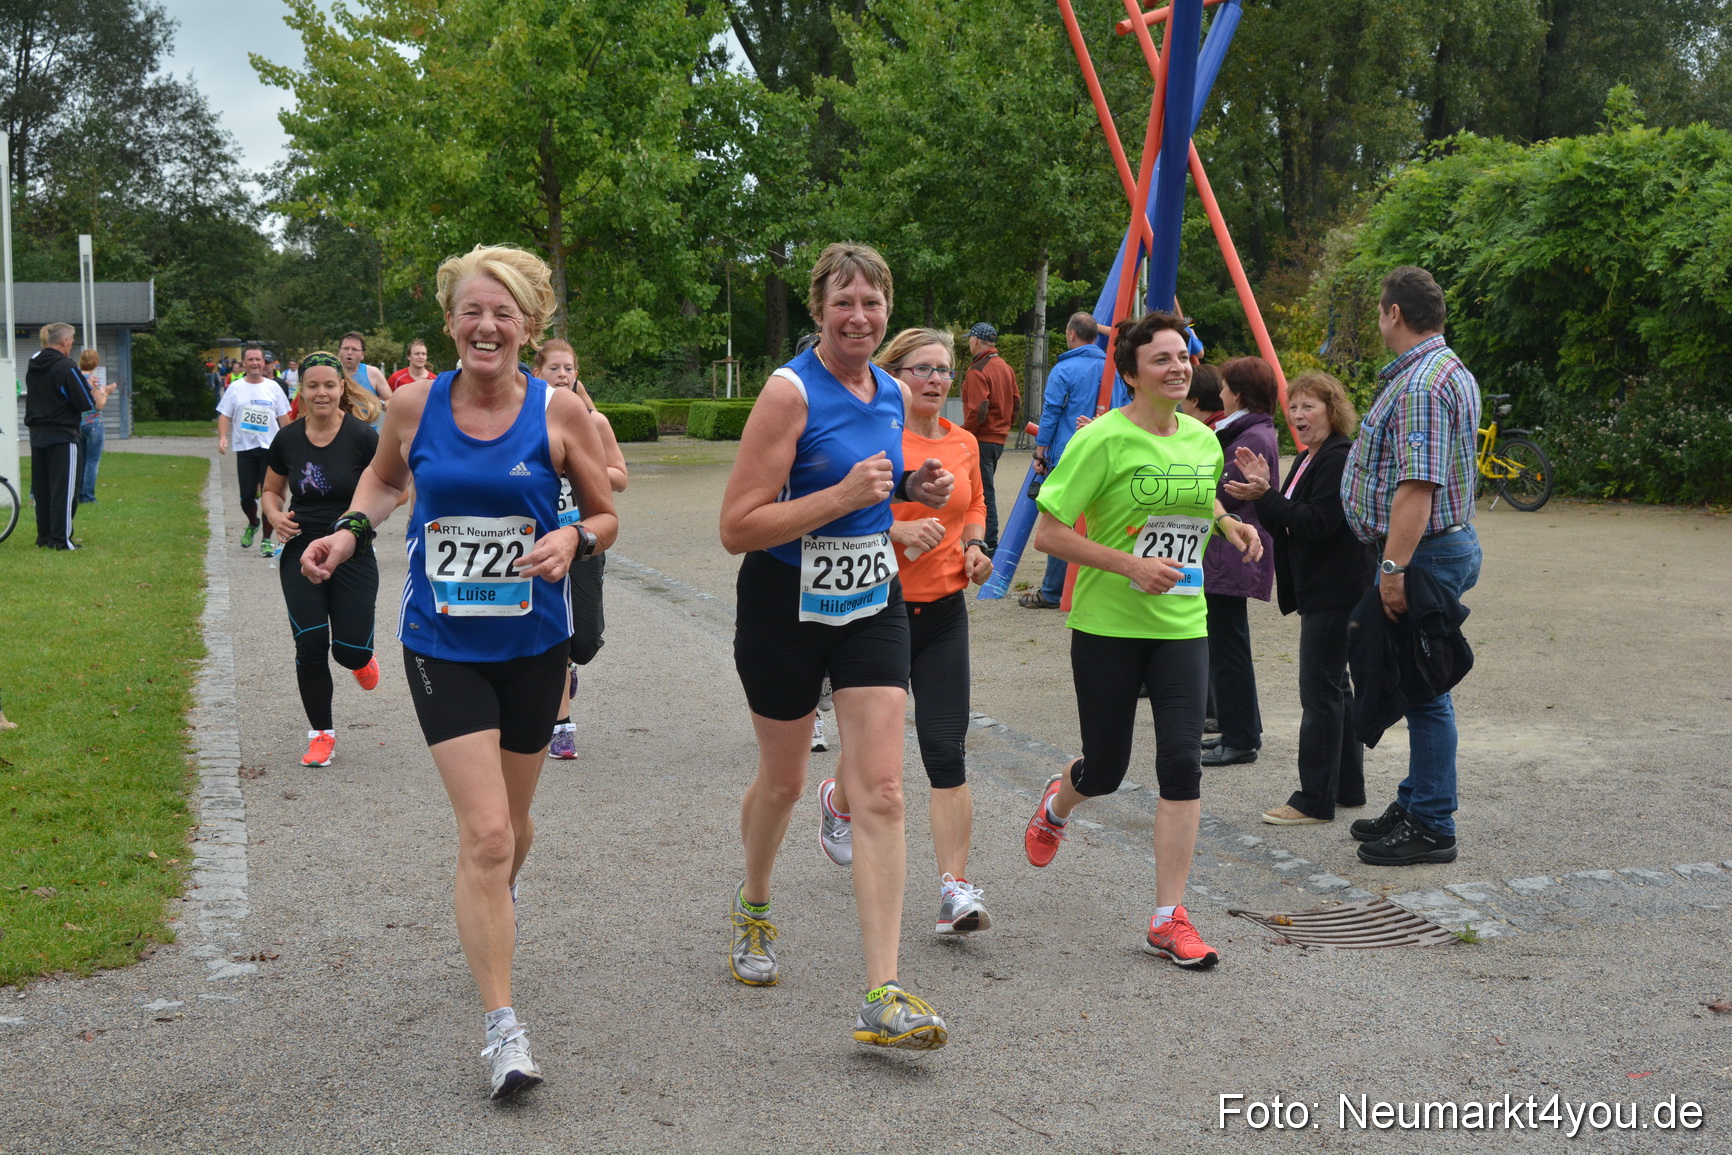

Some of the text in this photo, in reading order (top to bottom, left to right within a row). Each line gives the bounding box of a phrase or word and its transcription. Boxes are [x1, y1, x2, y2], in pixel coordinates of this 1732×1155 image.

[244, 412, 268, 425] 2652
[467, 527, 516, 537] Neumarkt
[1166, 521, 1199, 531] Neumarkt
[804, 538, 880, 550] PARTL Neumarkt
[1142, 532, 1198, 563] 2372
[437, 540, 524, 577] 2722
[812, 551, 890, 590] 2326
[457, 587, 496, 601] Luise
[821, 591, 874, 613] Hildegard
